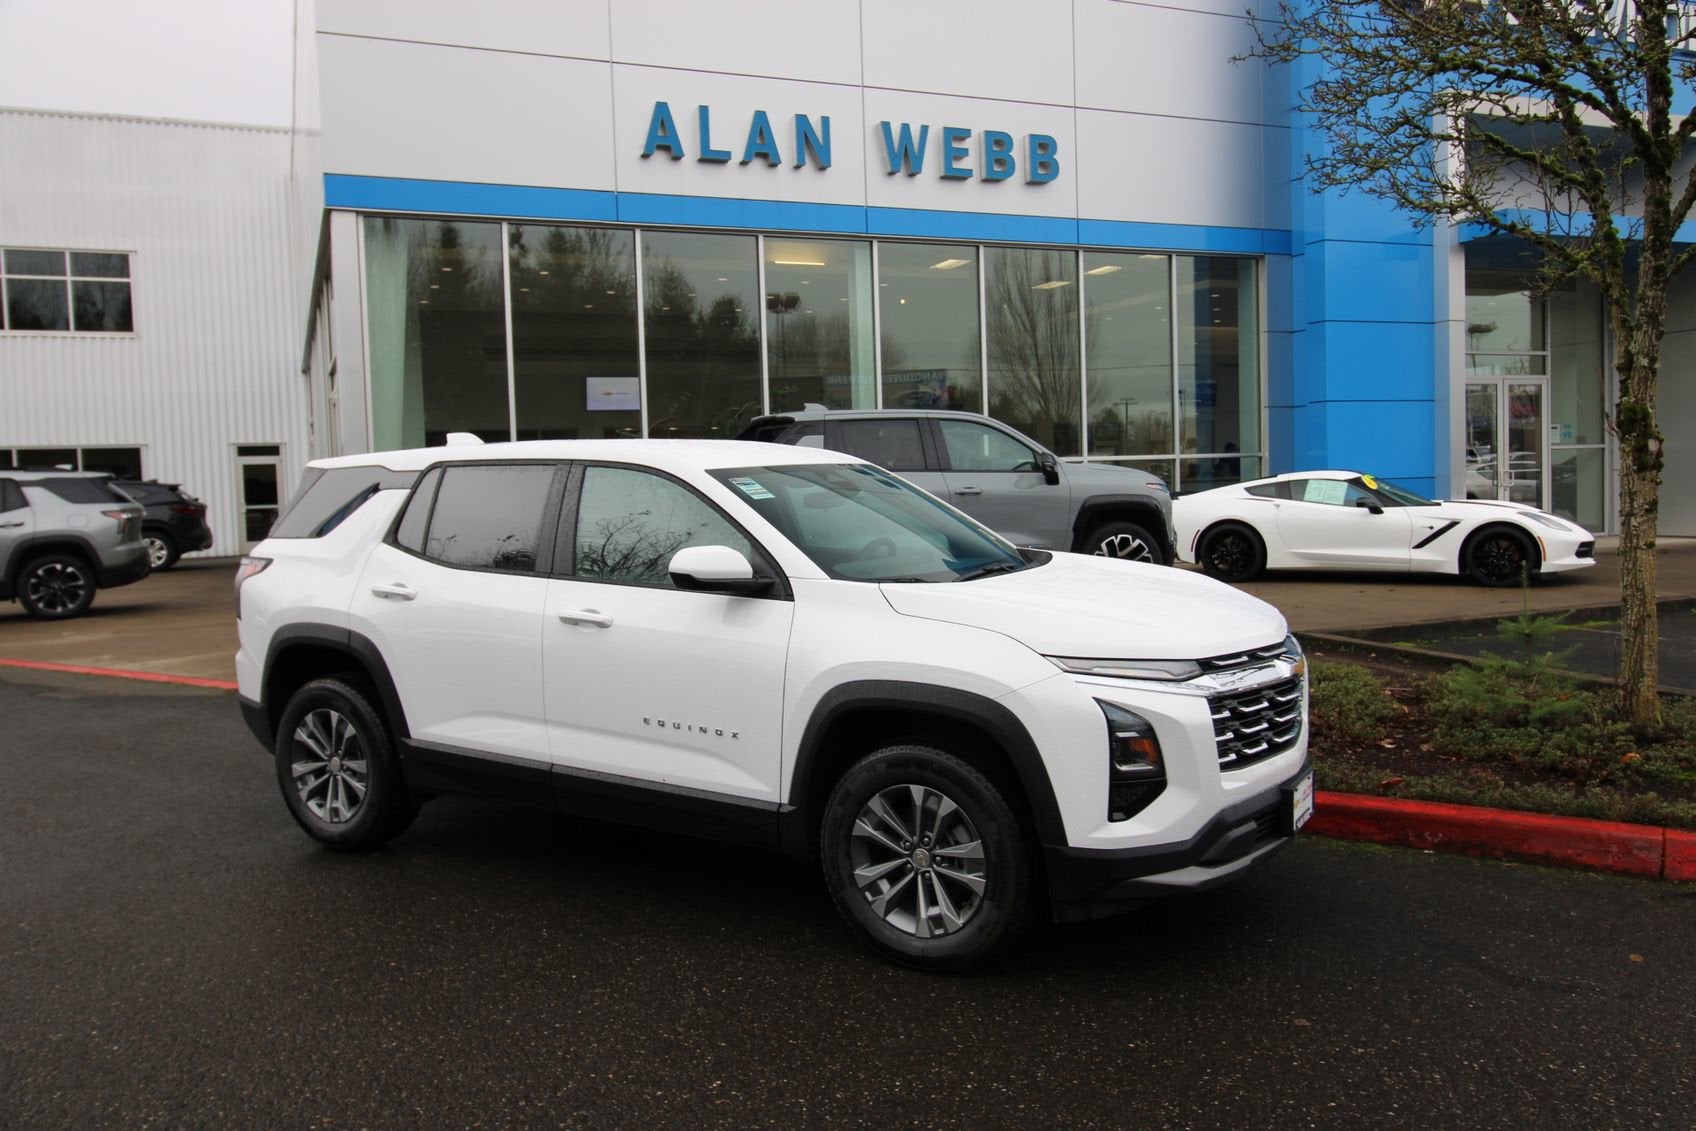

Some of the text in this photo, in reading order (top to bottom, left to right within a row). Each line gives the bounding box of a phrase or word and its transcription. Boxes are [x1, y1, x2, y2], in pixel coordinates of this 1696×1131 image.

[641, 101, 1059, 184] ALAN WEBB
[643, 717, 739, 739] EQUINOX
